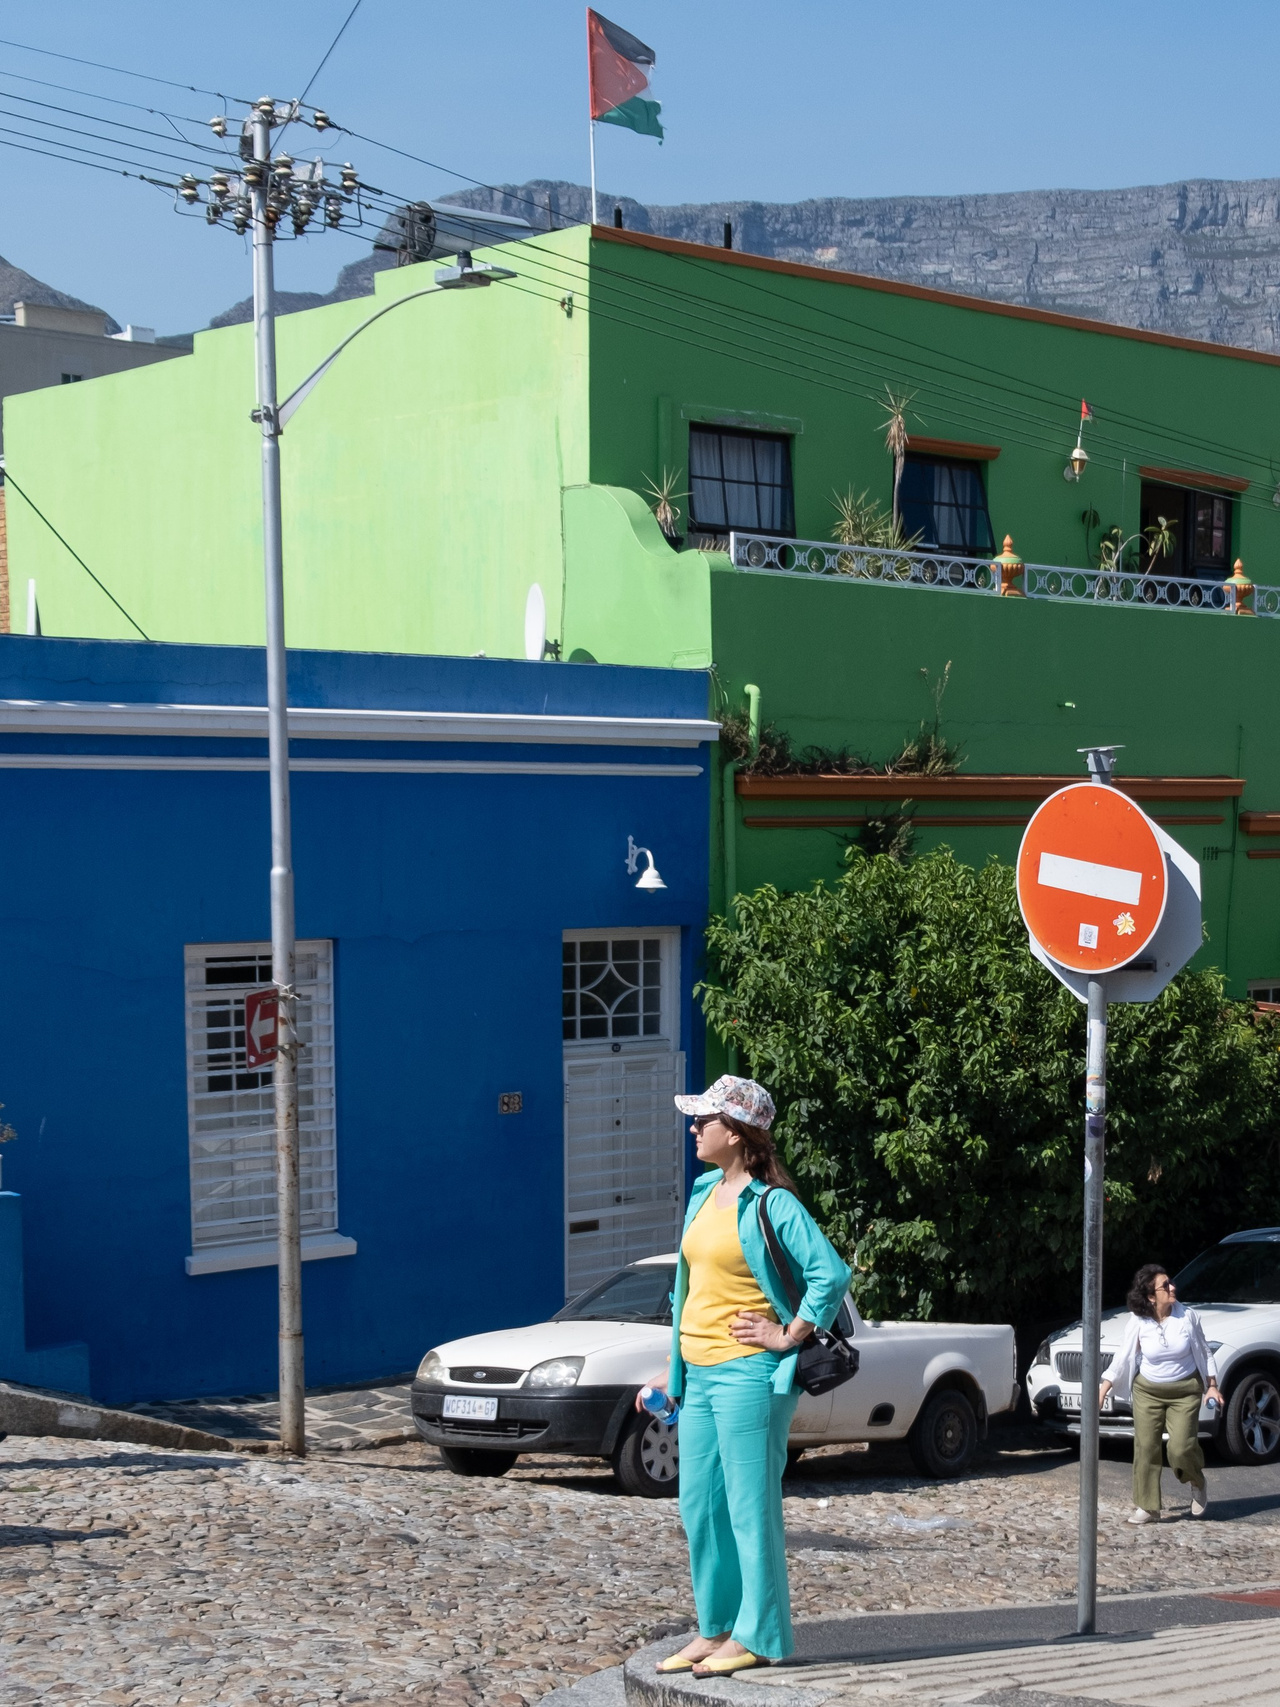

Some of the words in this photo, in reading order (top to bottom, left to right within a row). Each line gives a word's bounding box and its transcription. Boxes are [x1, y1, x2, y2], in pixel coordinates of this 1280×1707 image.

[501, 1094, 521, 1112] 83
[445, 1399, 477, 1415] WCF314
[484, 1401, 496, 1416] GP
